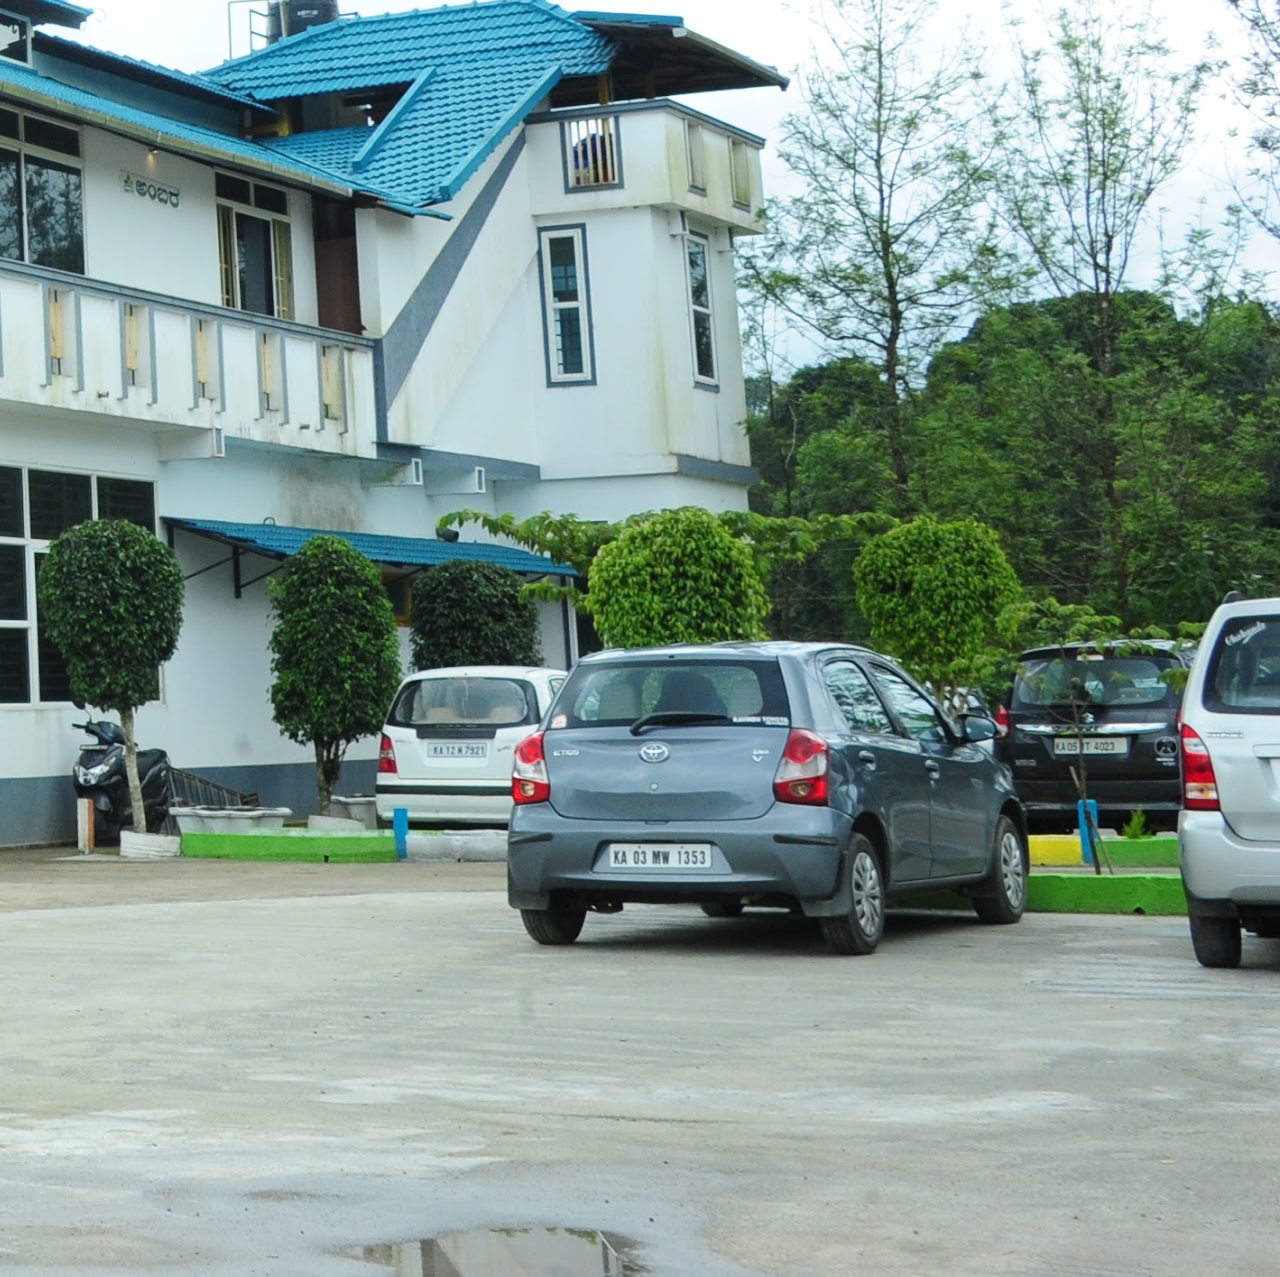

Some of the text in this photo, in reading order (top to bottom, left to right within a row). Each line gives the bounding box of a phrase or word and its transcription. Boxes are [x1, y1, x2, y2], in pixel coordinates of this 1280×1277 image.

[433, 746, 444, 755] KA
[446, 746, 456, 755] 12
[464, 746, 485, 755] 7921
[1055, 741, 1066, 752] KA
[1067, 741, 1078, 751] 05
[1093, 740, 1116, 752] 4023
[613, 850, 707, 865] KA 03 MW 1353
